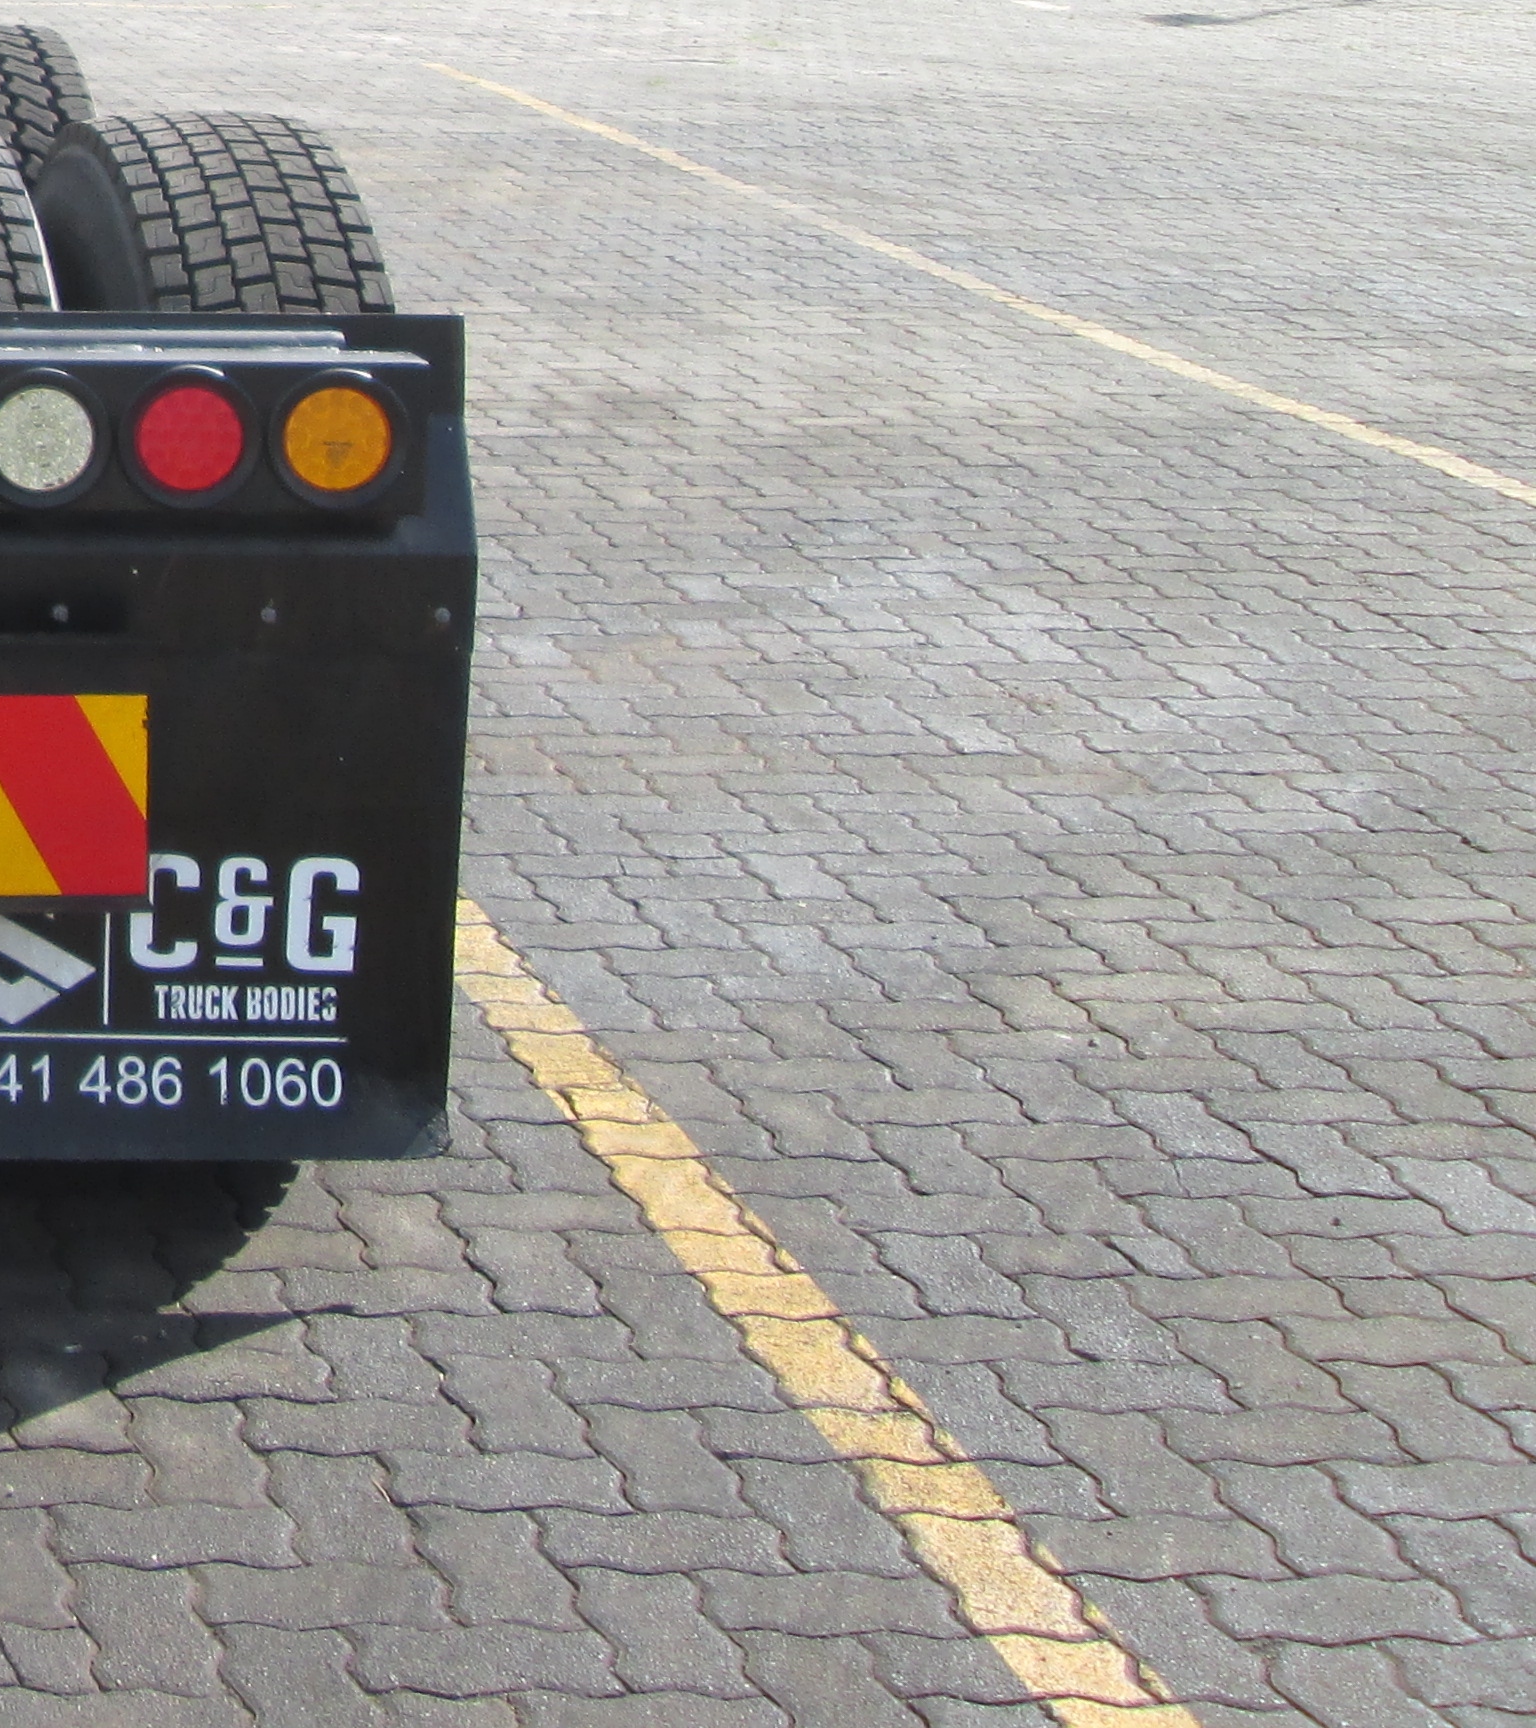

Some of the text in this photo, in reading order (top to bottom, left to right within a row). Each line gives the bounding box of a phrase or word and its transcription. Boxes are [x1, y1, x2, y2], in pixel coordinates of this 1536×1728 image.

[129, 853, 361, 972] C&G
[154, 984, 337, 1022] TRUCK BODIES
[78, 1055, 183, 1106] 486
[208, 1056, 343, 1108] 1060
